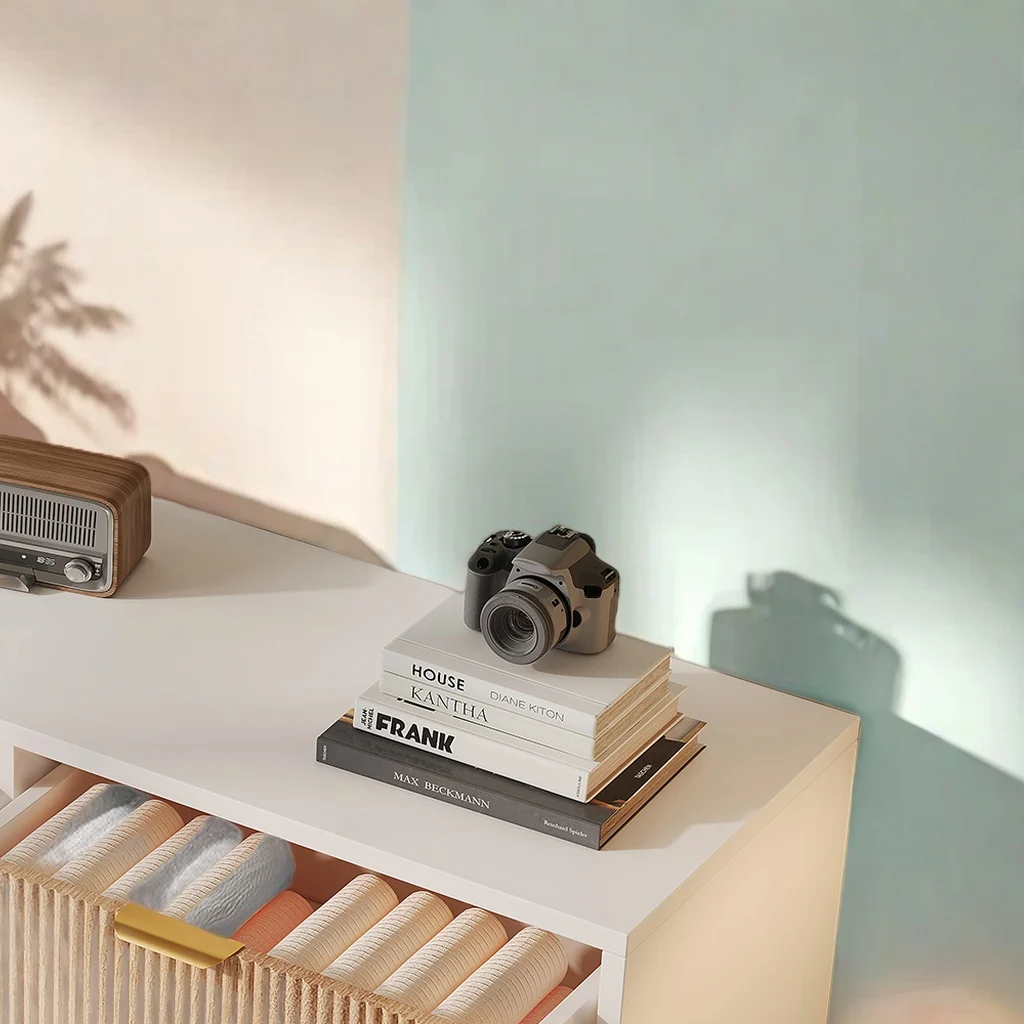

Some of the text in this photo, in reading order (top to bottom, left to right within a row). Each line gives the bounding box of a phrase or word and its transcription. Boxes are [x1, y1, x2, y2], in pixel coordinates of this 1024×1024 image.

[410, 685, 489, 723] KANTHA
[412, 664, 565, 723] HOUSE DIANE KITON
[375, 712, 456, 754] FRANK
[393, 771, 491, 809] MAX BECKMANN
